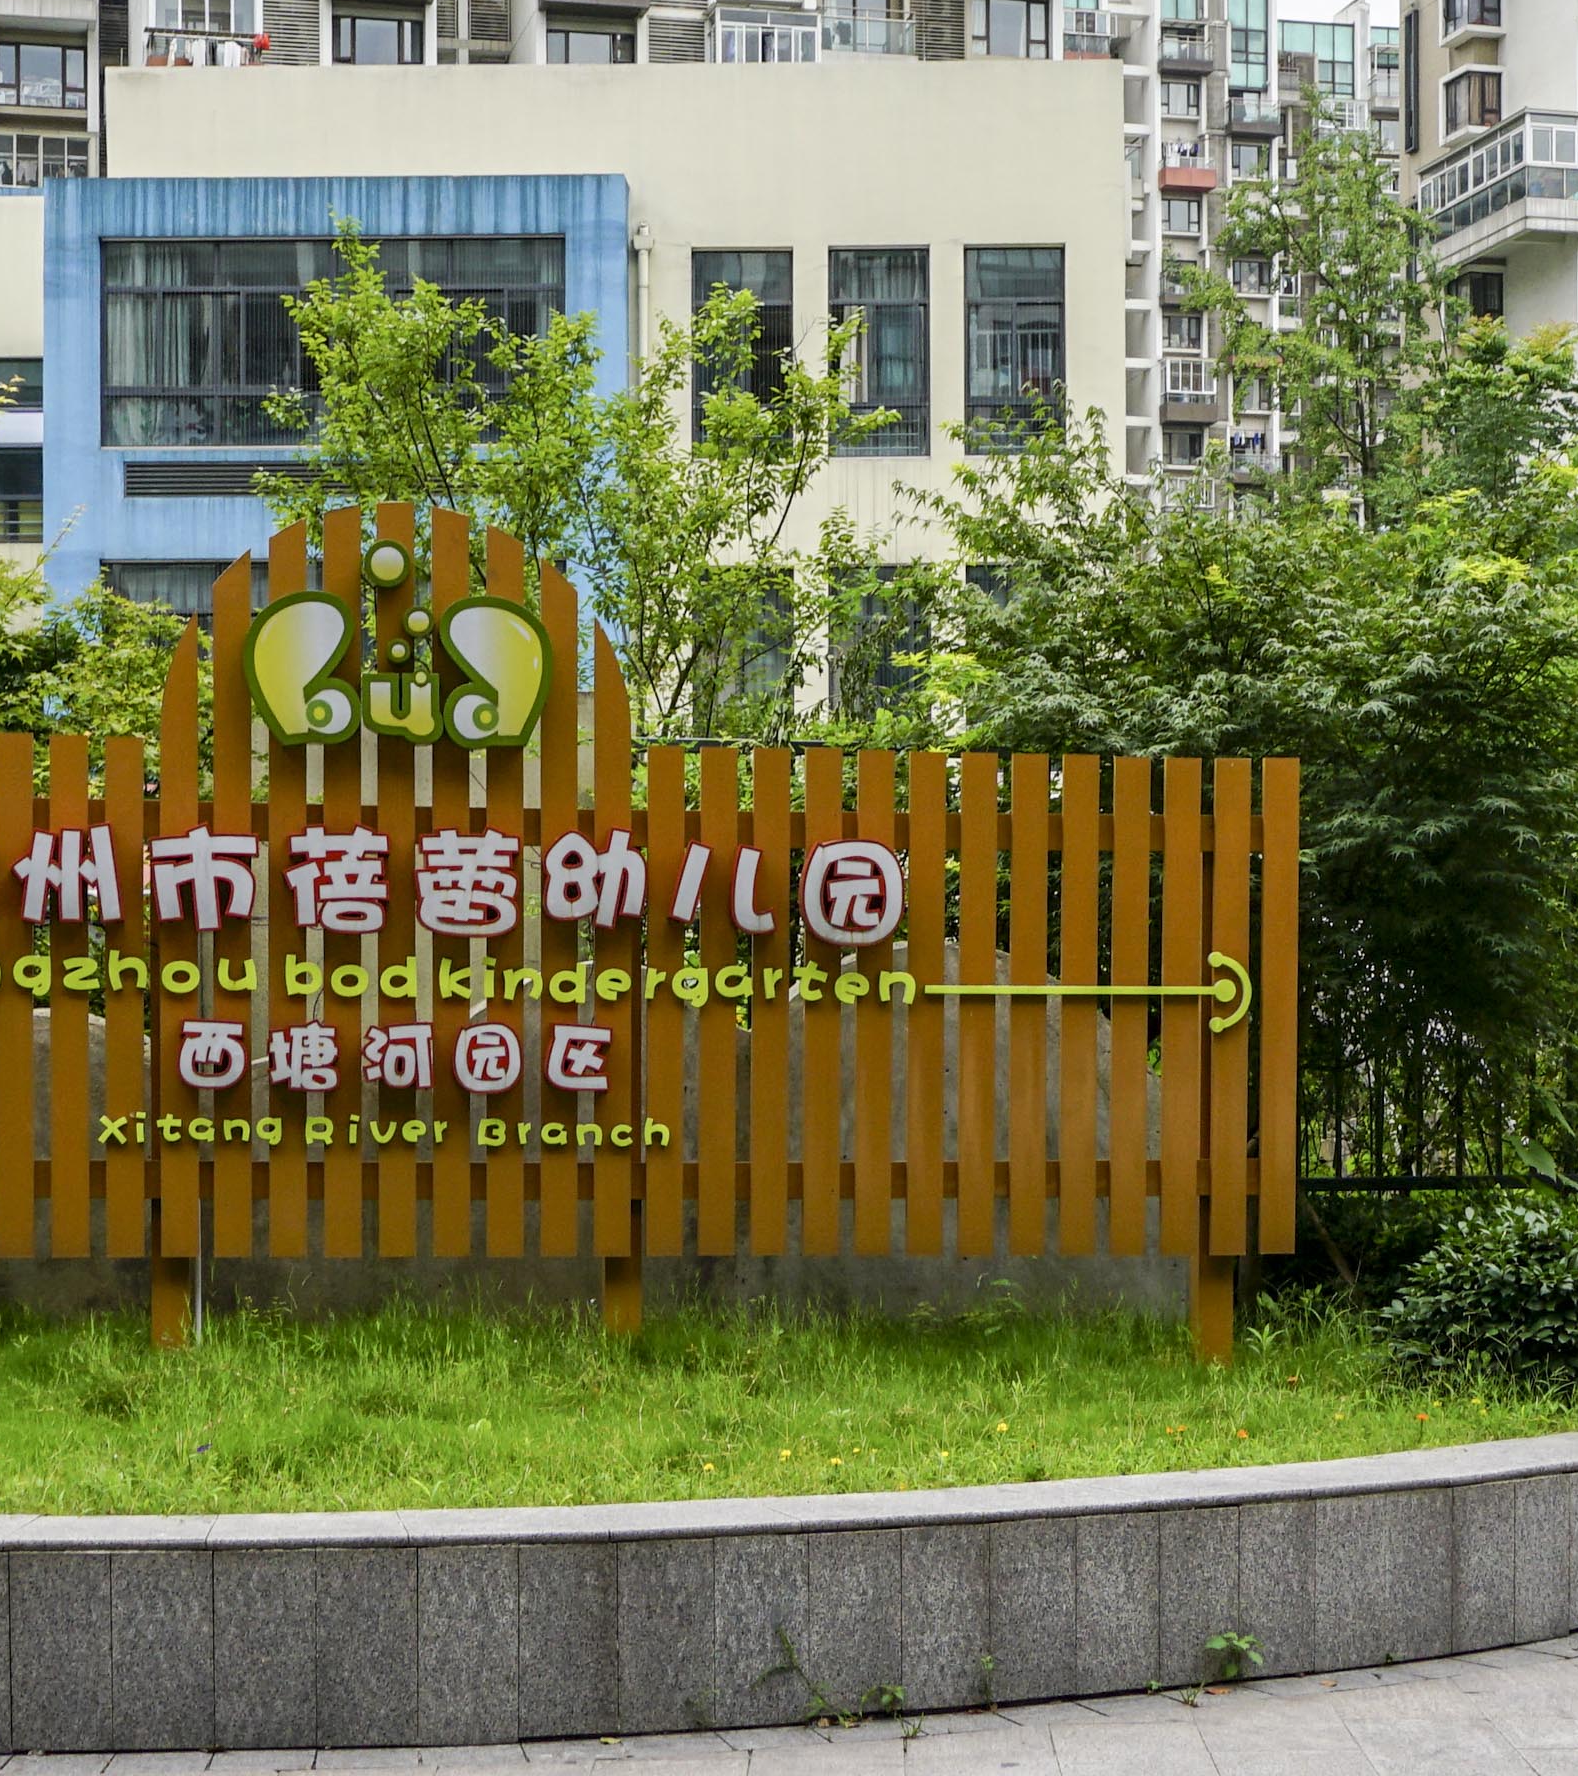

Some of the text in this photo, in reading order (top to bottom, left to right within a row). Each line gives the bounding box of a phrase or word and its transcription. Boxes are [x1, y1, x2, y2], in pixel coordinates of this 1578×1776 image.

[178, 1019, 613, 1093] 西塘河园区
[305, 1113, 448, 1145] River
[477, 1117, 671, 1148] Branch
